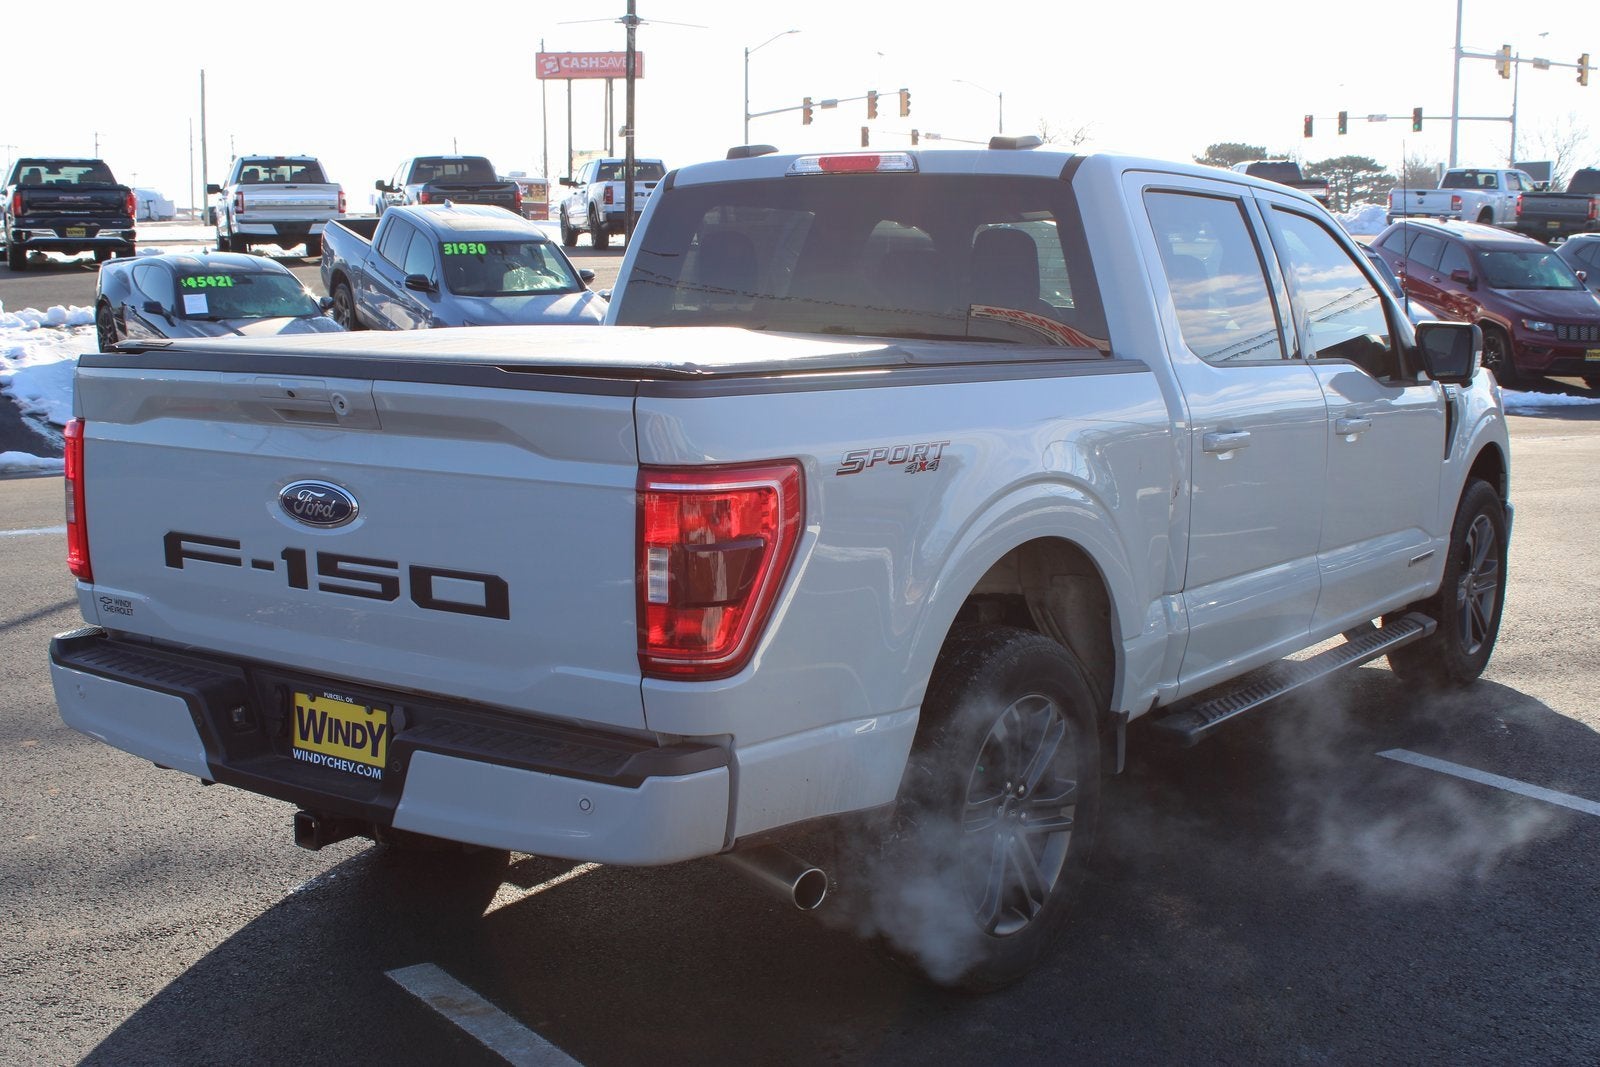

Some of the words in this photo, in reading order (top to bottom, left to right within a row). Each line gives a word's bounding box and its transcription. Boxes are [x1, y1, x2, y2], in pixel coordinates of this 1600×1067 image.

[443, 242, 487, 255] 31930
[836, 440, 950, 476] SPORT
[293, 489, 336, 518] Ford
[163, 531, 511, 621] F-150
[296, 705, 387, 758] WINDY
[292, 747, 382, 780] WINDYCHEV.COM
